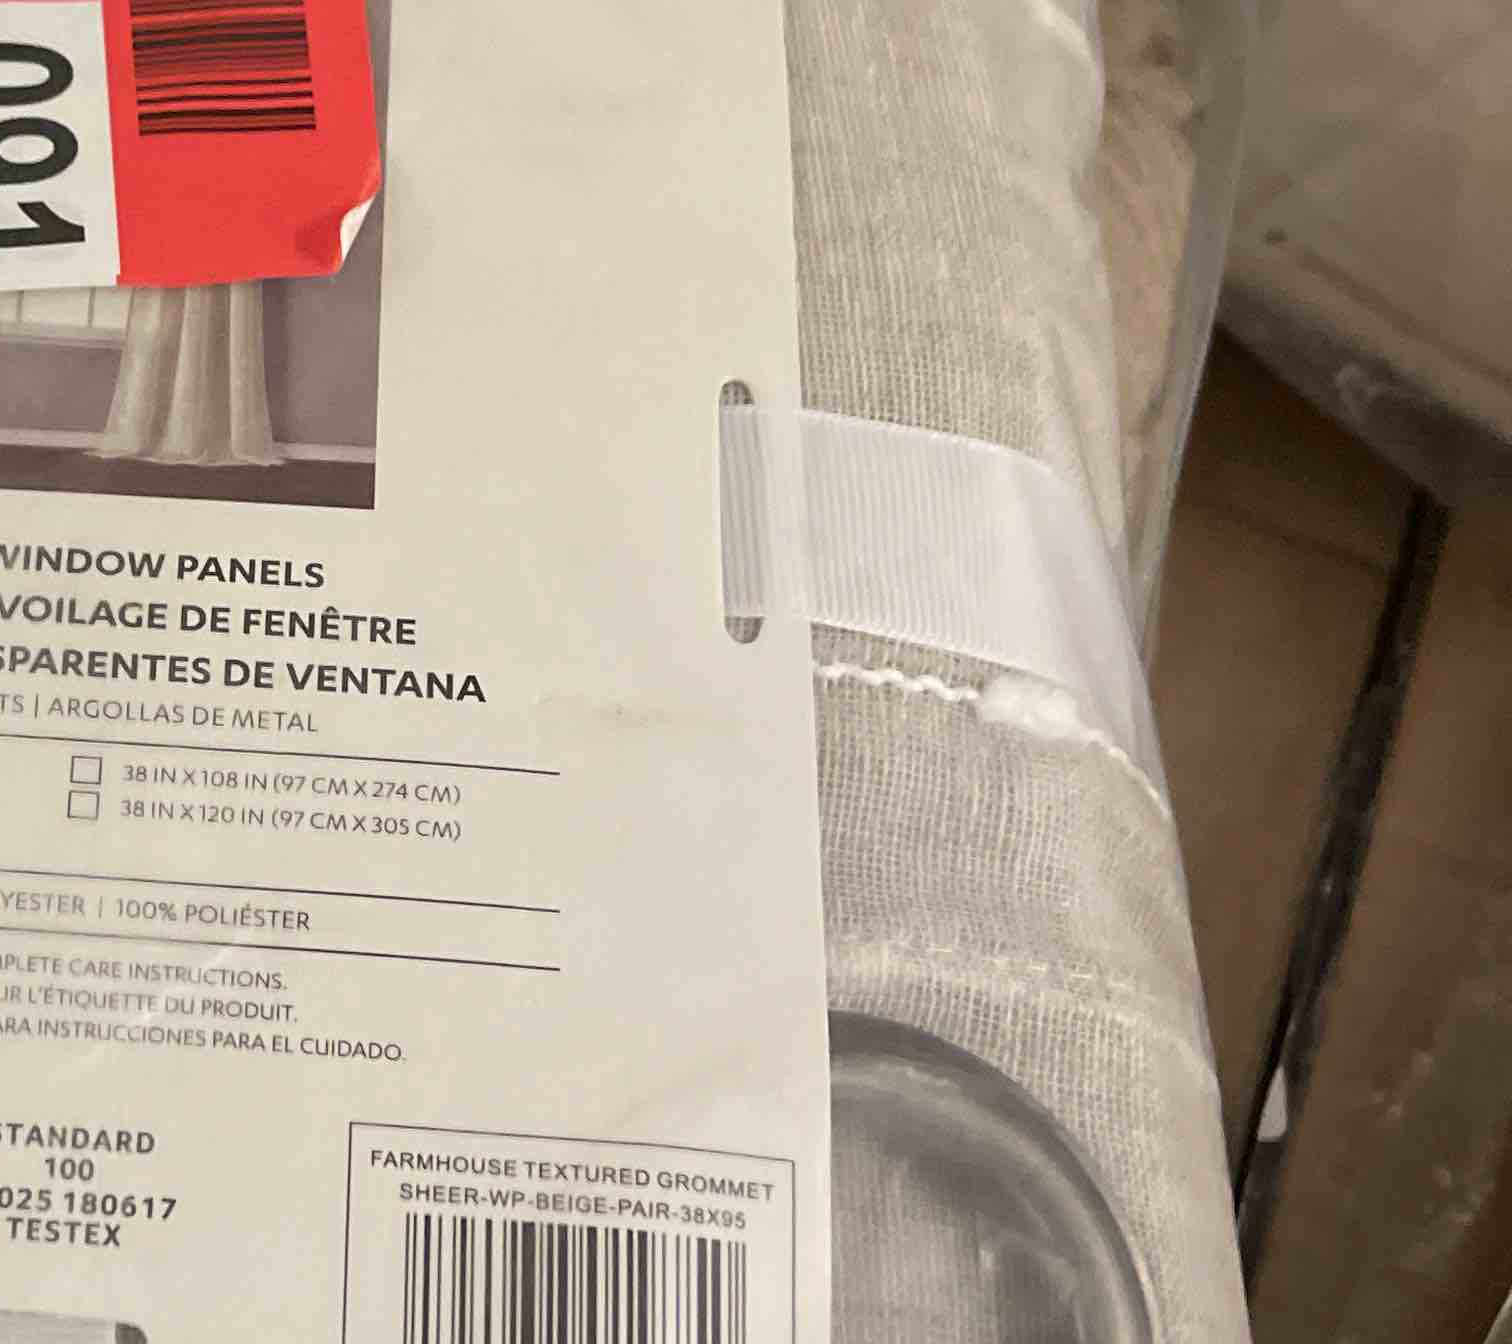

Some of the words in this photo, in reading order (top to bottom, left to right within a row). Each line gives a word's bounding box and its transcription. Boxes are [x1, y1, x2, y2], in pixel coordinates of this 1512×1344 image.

[177, 555, 325, 589] PANELS
[180, 604, 232, 634] DE
[243, 606, 417, 646] FENÊTRE
[223, 658, 275, 689] DE
[286, 662, 487, 703] VENTANA
[48, 698, 185, 725] ARGOLLAS
[192, 705, 224, 727] DE
[232, 708, 319, 733] METAL
[122, 764, 148, 783] 38
[153, 766, 177, 785] IN
[202, 768, 238, 789] 108
[245, 771, 268, 792] IN
[273, 772, 306, 795] (97
[310, 776, 349, 796] CM
[373, 780, 408, 800] 274
[414, 783, 462, 806] CM)
[121, 799, 145, 818] 38
[151, 801, 174, 820] IN
[199, 802, 236, 825] 120
[241, 805, 264, 826] IN
[271, 807, 305, 831] (97
[310, 811, 348, 832] CM
[372, 814, 410, 837] 305
[414, 818, 462, 842] CM)
[117, 897, 178, 921] 100%
[184, 899, 311, 932] POLIÉSTER
[68, 957, 121, 979] CARE
[128, 962, 289, 991] INSTRUCTIONS.
[28, 984, 157, 1014] L'ÉTIQUETTE
[164, 996, 195, 1016] DU
[200, 999, 298, 1024] PRODUIT.
[37, 1019, 207, 1049] INSTRUCCIONES
[212, 1031, 266, 1054] PARA
[272, 1034, 294, 1055] EL
[299, 1037, 407, 1063] CUIDADO.
[44, 1157, 95, 1183] 100
[370, 1149, 517, 1178] FARMHOUSE
[524, 1160, 650, 1188] TEXTURED
[657, 1171, 776, 1202] GROMMET
[64, 1192, 178, 1221] 180617
[399, 1182, 747, 1230] SHEER-WP-BEIGE-PAIR-38X95
[6, 1216, 122, 1249] TESTEX
